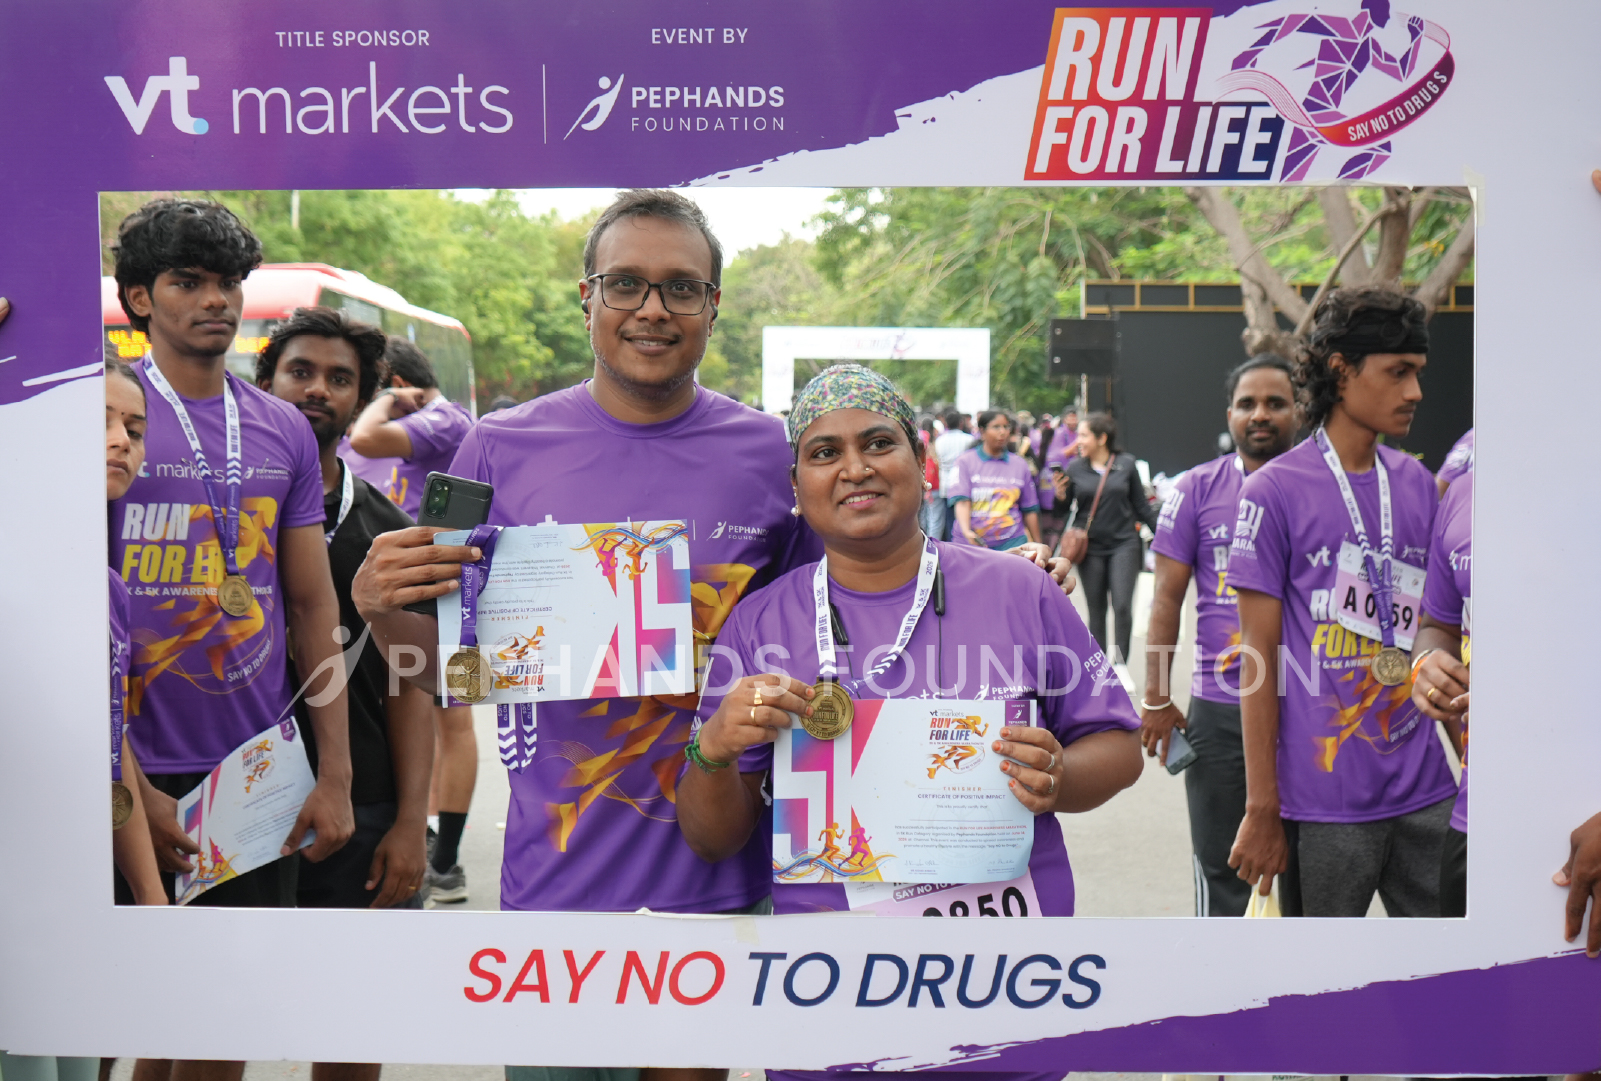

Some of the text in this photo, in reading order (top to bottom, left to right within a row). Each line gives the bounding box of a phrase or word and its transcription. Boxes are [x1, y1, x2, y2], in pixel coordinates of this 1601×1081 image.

[275, 29, 430, 48] TITLE SPONSOR
[651, 28, 748, 45] EVENT BY
[1047, 16, 1202, 102] RUN
[232, 61, 514, 135] markets
[631, 85, 785, 108] PEPHANDS
[631, 116, 785, 133] FOUNDATION
[1347, 122, 1371, 142] SAY
[1370, 114, 1392, 135] NO
[1387, 105, 1409, 127] TO
[1033, 105, 1280, 175] FOR LIFE
[121, 503, 191, 540] RUN
[121, 544, 187, 583] FOR
[462, 566, 473, 620] vt markets
[1343, 585, 1357, 614] A
[1365, 593, 1413, 630] 059
[906, 614, 918, 626] LIFE
[902, 625, 914, 637] FOR
[504, 663, 544, 676] FOR LIFE
[524, 674, 544, 686] RUN
[930, 718, 951, 728] RUN
[940, 709, 964, 717] markets
[930, 730, 972, 740] FOR LIFE
[895, 888, 914, 899] SAY
[916, 884, 932, 895] NO
[922, 886, 1028, 917] 50
[463, 947, 1107, 1010] SAY NO TO DRUGS
